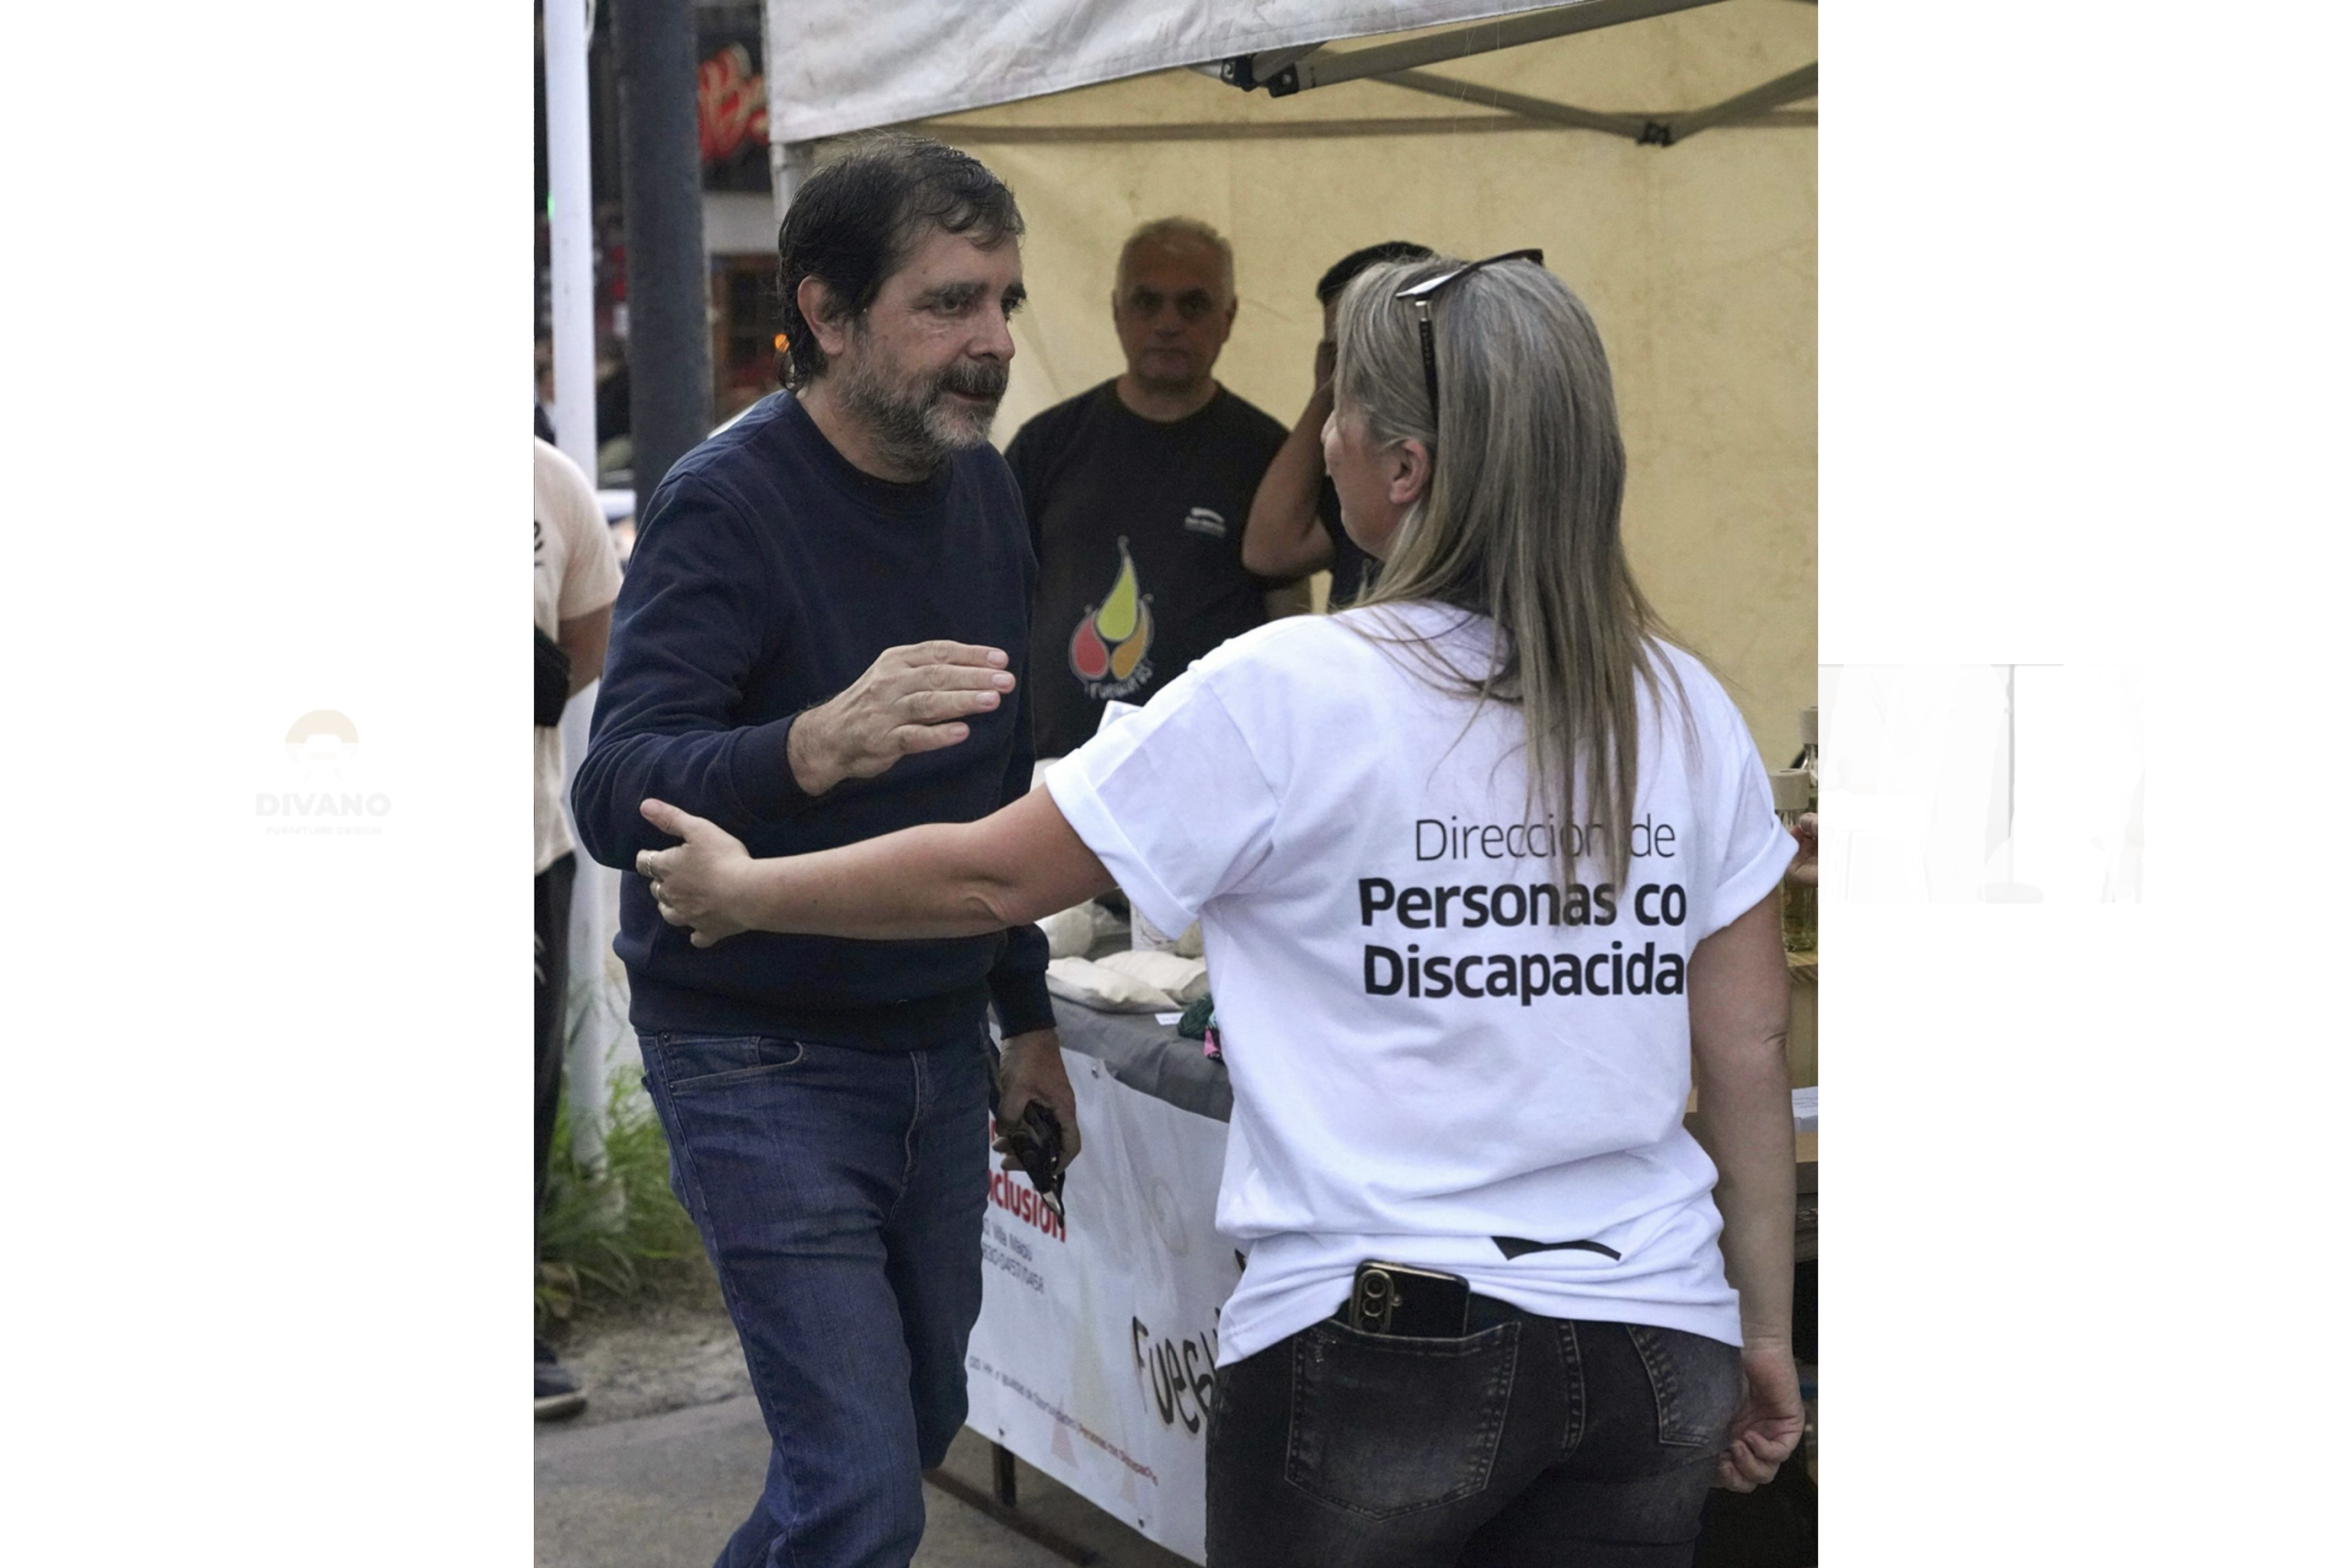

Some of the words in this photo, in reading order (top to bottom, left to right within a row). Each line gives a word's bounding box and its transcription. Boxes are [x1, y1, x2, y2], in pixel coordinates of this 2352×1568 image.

[1630, 813, 1676, 858] de
[1359, 877, 1618, 929] Personas
[1634, 883, 1687, 927] co
[1364, 941, 1685, 1006] Discapacida
